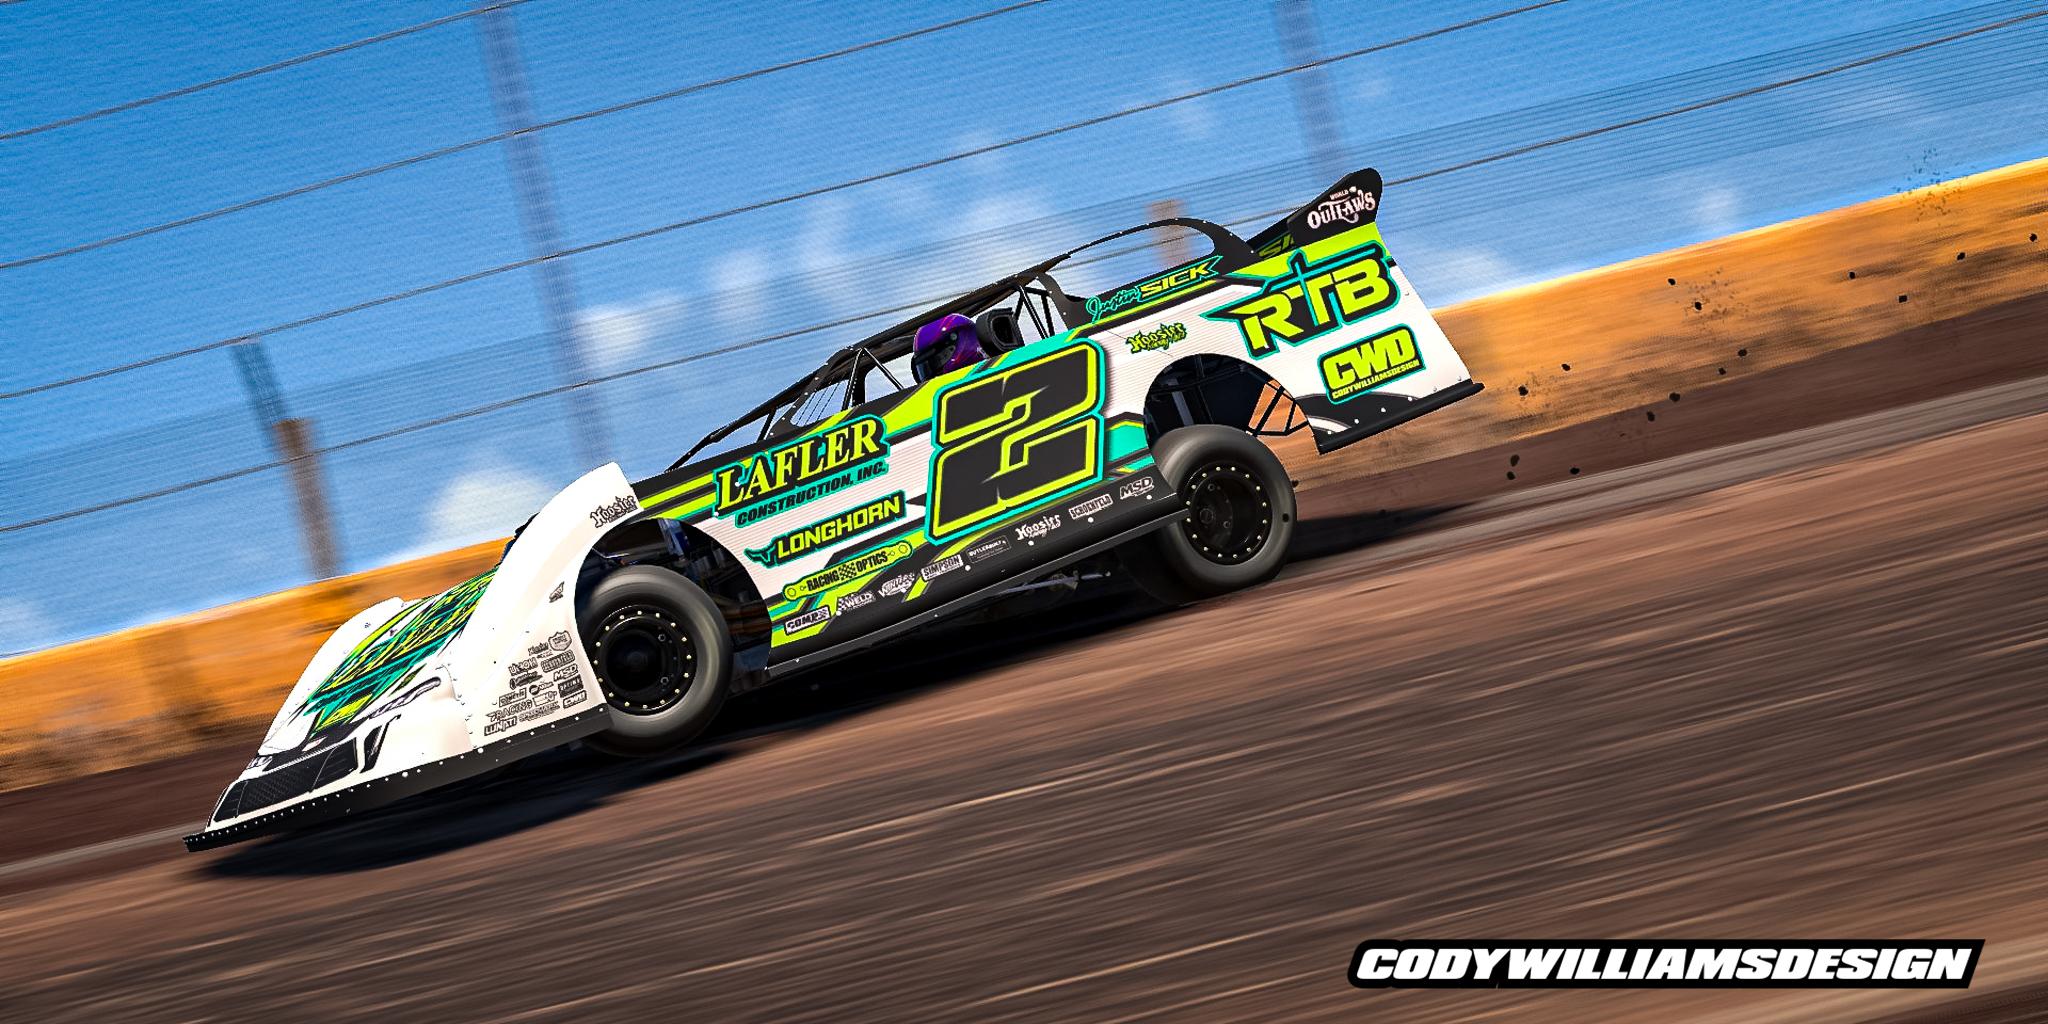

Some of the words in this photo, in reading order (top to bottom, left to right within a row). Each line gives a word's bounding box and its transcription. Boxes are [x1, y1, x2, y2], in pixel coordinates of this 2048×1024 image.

[1140, 262, 1209, 298] SICK
[1228, 258, 1390, 350] RTB
[1323, 328, 1416, 390] CWD
[1332, 359, 1420, 400] CODYWILLIAMSDESIGN
[934, 344, 1096, 537] 2
[717, 419, 880, 511] LAFLER
[857, 461, 887, 481] INC.
[1070, 495, 1112, 518] SCHOENFELD
[1120, 477, 1153, 499] MSD
[777, 496, 900, 559] LONGHORN
[807, 569, 840, 592] RACING
[856, 551, 888, 572] OPTICS
[923, 555, 960, 577] SIMPSON
[554, 663, 578, 681] MSD
[484, 715, 517, 736] LUNATI
